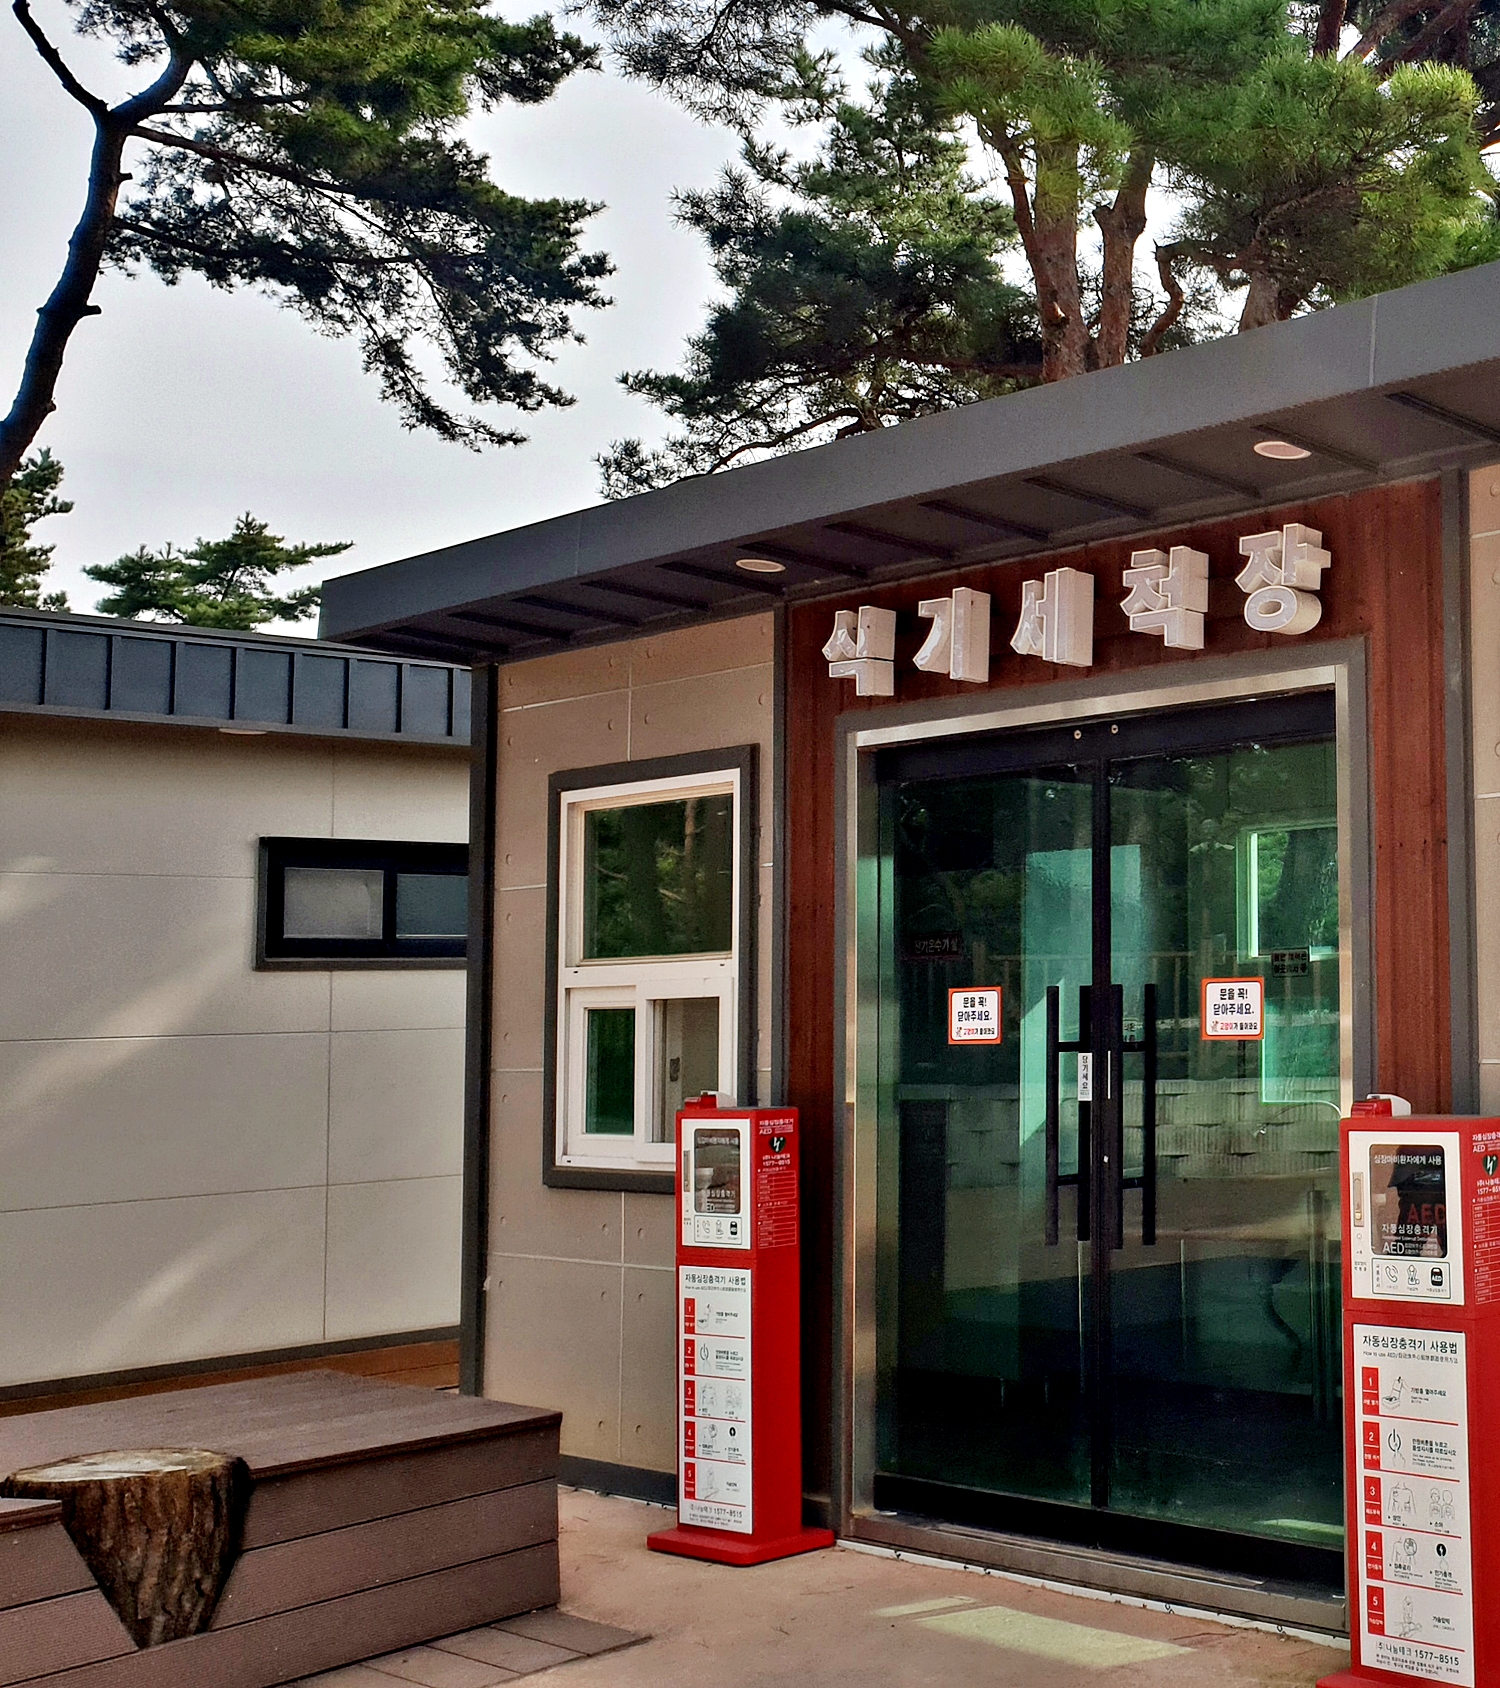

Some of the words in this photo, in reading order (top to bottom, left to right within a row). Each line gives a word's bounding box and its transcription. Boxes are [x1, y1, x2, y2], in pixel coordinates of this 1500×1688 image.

[821, 523, 1332, 696] 식기세척장
[1220, 988, 1235, 1000] 문을
[1237, 987, 1248, 1000] 꼭!
[963, 996, 976, 1008] 문을
[978, 996, 987, 1007] 꼭!
[1213, 1003, 1254, 1015] 닫아주세요.
[1473, 1144, 1486, 1153] AED
[1428, 1155, 1442, 1166] 사용
[1407, 1203, 1446, 1223] AED
[1382, 1223, 1438, 1235] 자동심장충격기
[1382, 1241, 1405, 1254] AED
[1362, 1335, 1426, 1351] 자동심장충격기
[1430, 1340, 1458, 1354] 사용법
[1368, 1432, 1374, 1441] 2
[1370, 1486, 1376, 1496] 3
[1371, 1541, 1377, 1551] 4
[1372, 1596, 1378, 1606] 5
[1414, 1649, 1460, 1666] 1577-8515
